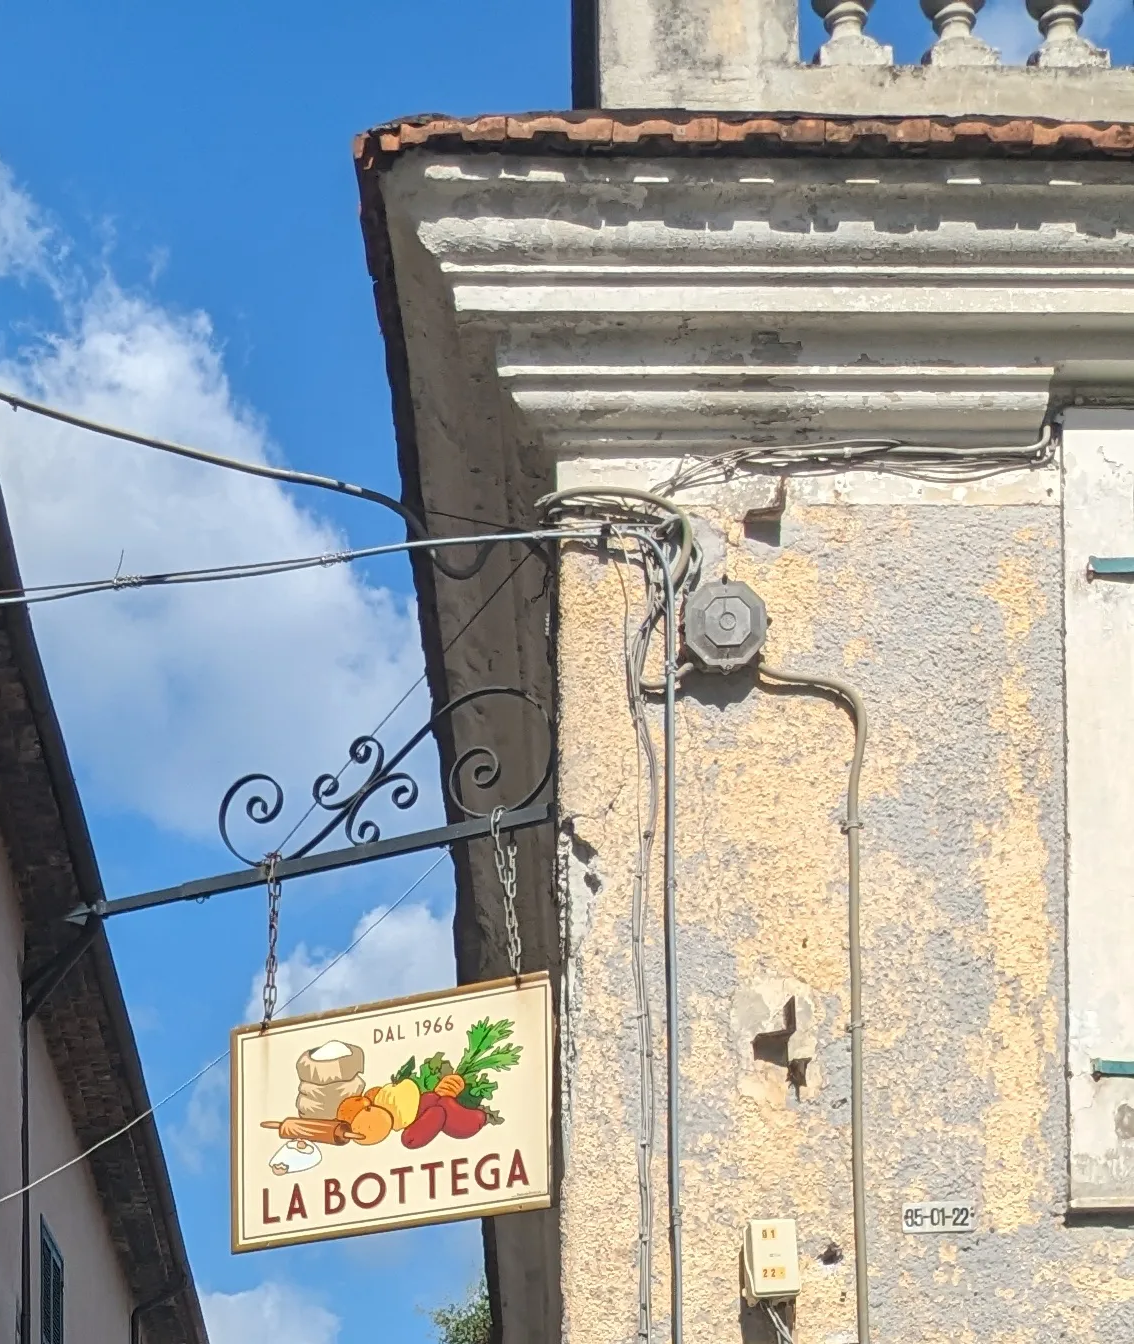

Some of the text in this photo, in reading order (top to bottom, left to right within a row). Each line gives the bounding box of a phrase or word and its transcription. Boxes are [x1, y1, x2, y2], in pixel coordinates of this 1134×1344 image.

[373, 1014, 454, 1045] DAL 1966
[262, 1148, 530, 1225] LA BOTTEGA
